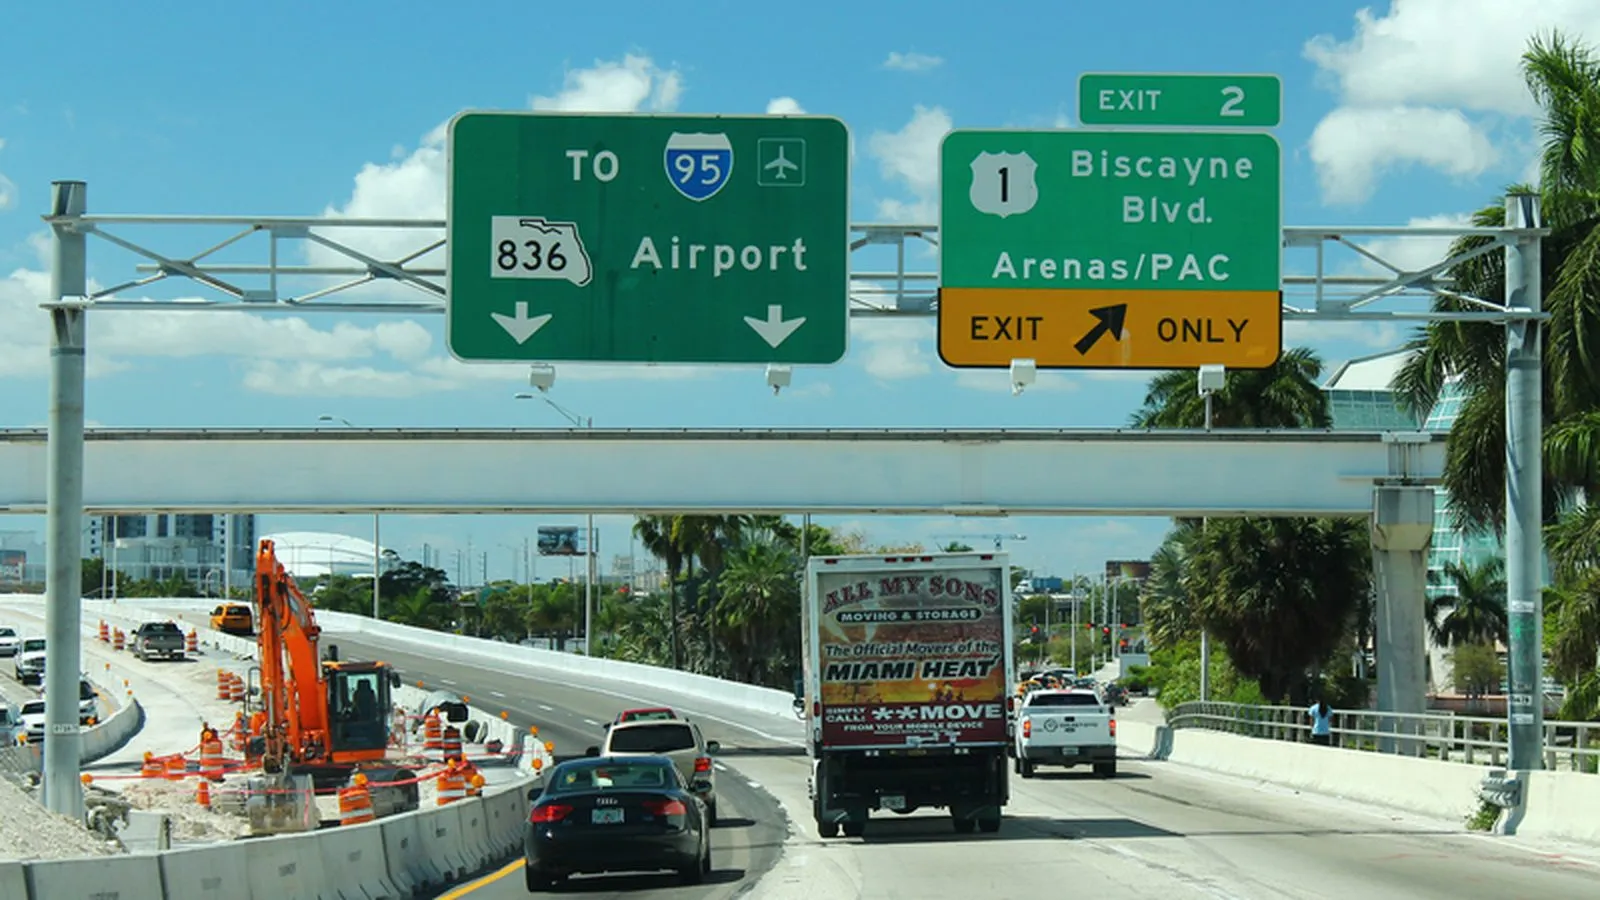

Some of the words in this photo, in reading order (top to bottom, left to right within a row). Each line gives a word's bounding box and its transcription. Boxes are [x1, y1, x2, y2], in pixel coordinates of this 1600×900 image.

[1099, 90, 1161, 110] EXIT
[1219, 86, 1245, 117] 2
[565, 149, 619, 182] TO
[674, 154, 721, 185] 95
[1071, 150, 1253, 185] Biscayne
[998, 167, 1008, 202] 1
[1122, 196, 1212, 223] Blvd.
[497, 240, 567, 271] 836
[630, 236, 807, 277] Airport
[991, 252, 1230, 281] Arenas/PAC
[971, 316, 1043, 341] EXIT
[1157, 318, 1249, 343] ONLY
[823, 580, 874, 614] ALL
[879, 575, 924, 597] MY
[929, 574, 999, 609] SONS
[841, 611, 897, 622] MOVING
[901, 611, 912, 621] &
[916, 609, 977, 620] STORAGE
[825, 643, 851, 657] The
[853, 642, 904, 656] Official
[905, 641, 954, 655] Movers
[957, 640, 973, 653] of
[975, 639, 1000, 653] the
[826, 661, 915, 681] MIAMI
[921, 653, 1001, 679] HEAT
[843, 723, 875, 732] FROM
[875, 722, 903, 731] YOUR
[905, 721, 945, 730] MOBILE
[946, 720, 984, 729] DEVICE
